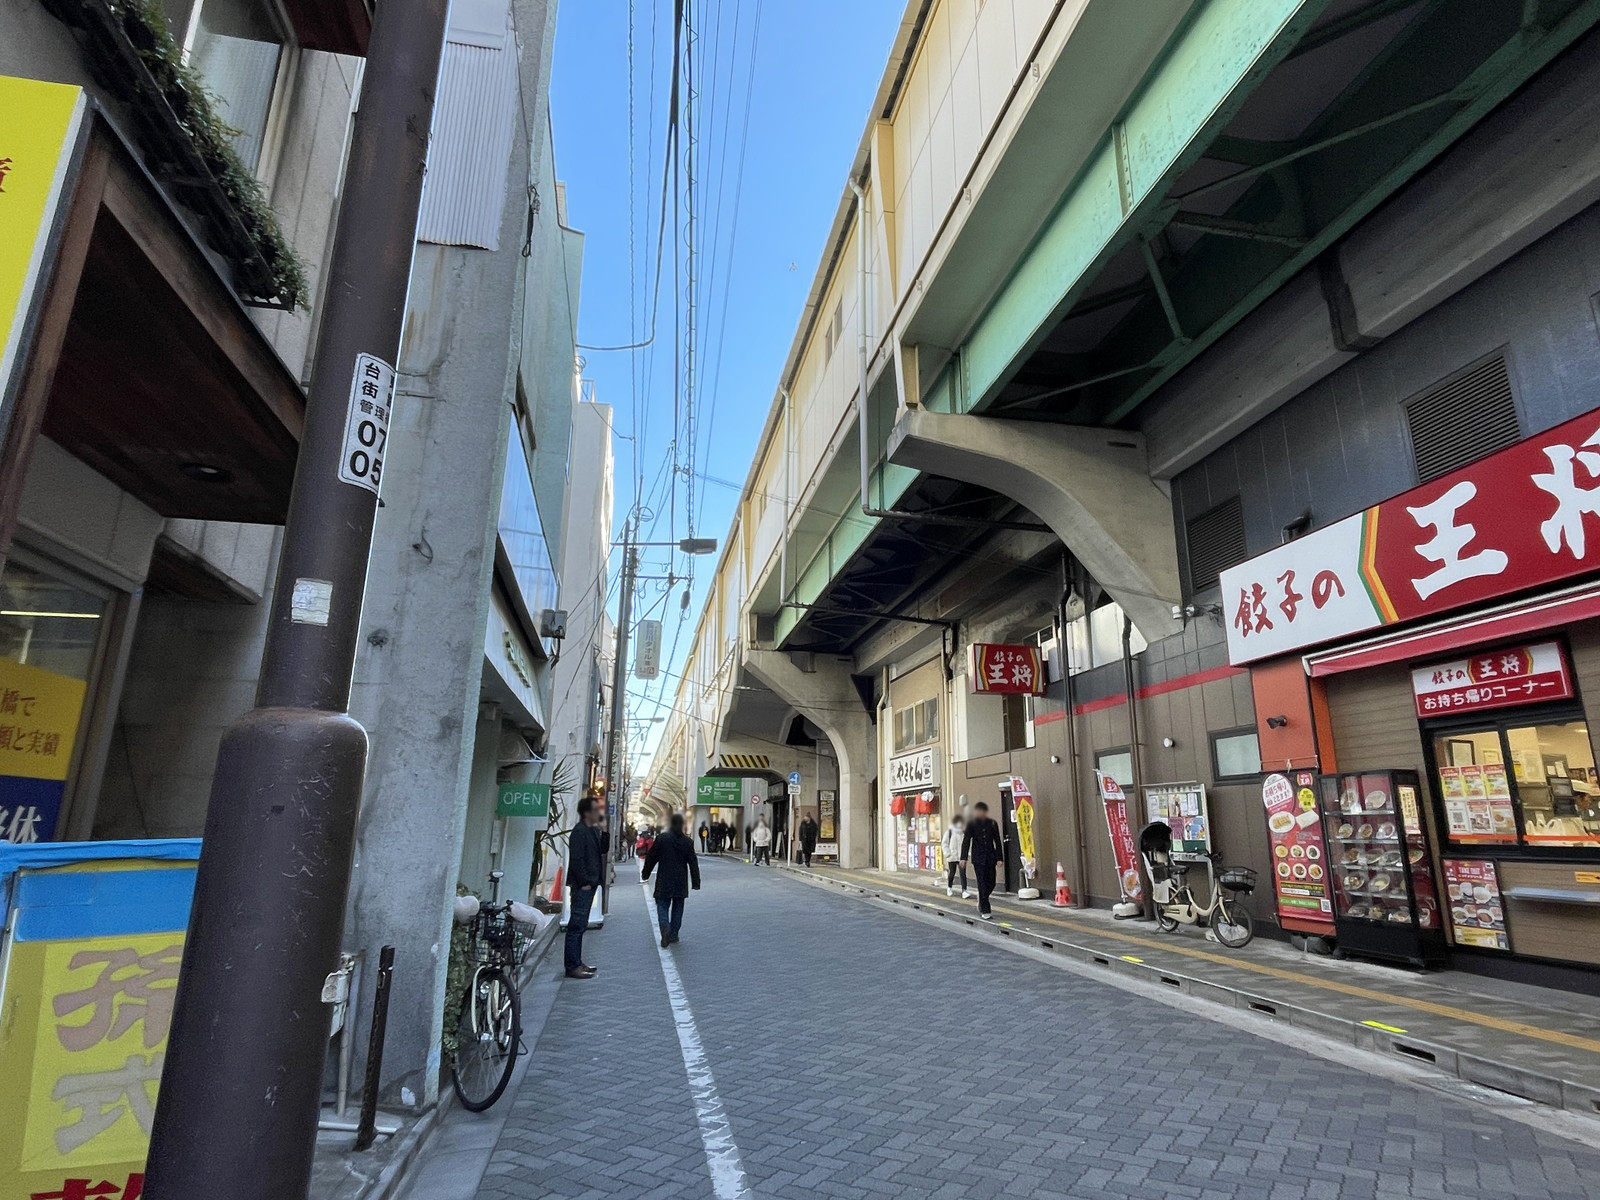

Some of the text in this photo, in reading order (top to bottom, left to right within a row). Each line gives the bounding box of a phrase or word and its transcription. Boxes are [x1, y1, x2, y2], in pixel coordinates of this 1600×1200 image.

[1234, 569, 1346, 638] 餃子の
[987, 663, 1033, 687] 王将
[1431, 653, 1520, 685] 餃子の 王将
[1424, 680, 1555, 710] お持ち帰りコーナー
[896, 757, 923, 785] やきとん
[503, 791, 542, 806] OPEN
[699, 785, 713, 794] JR
